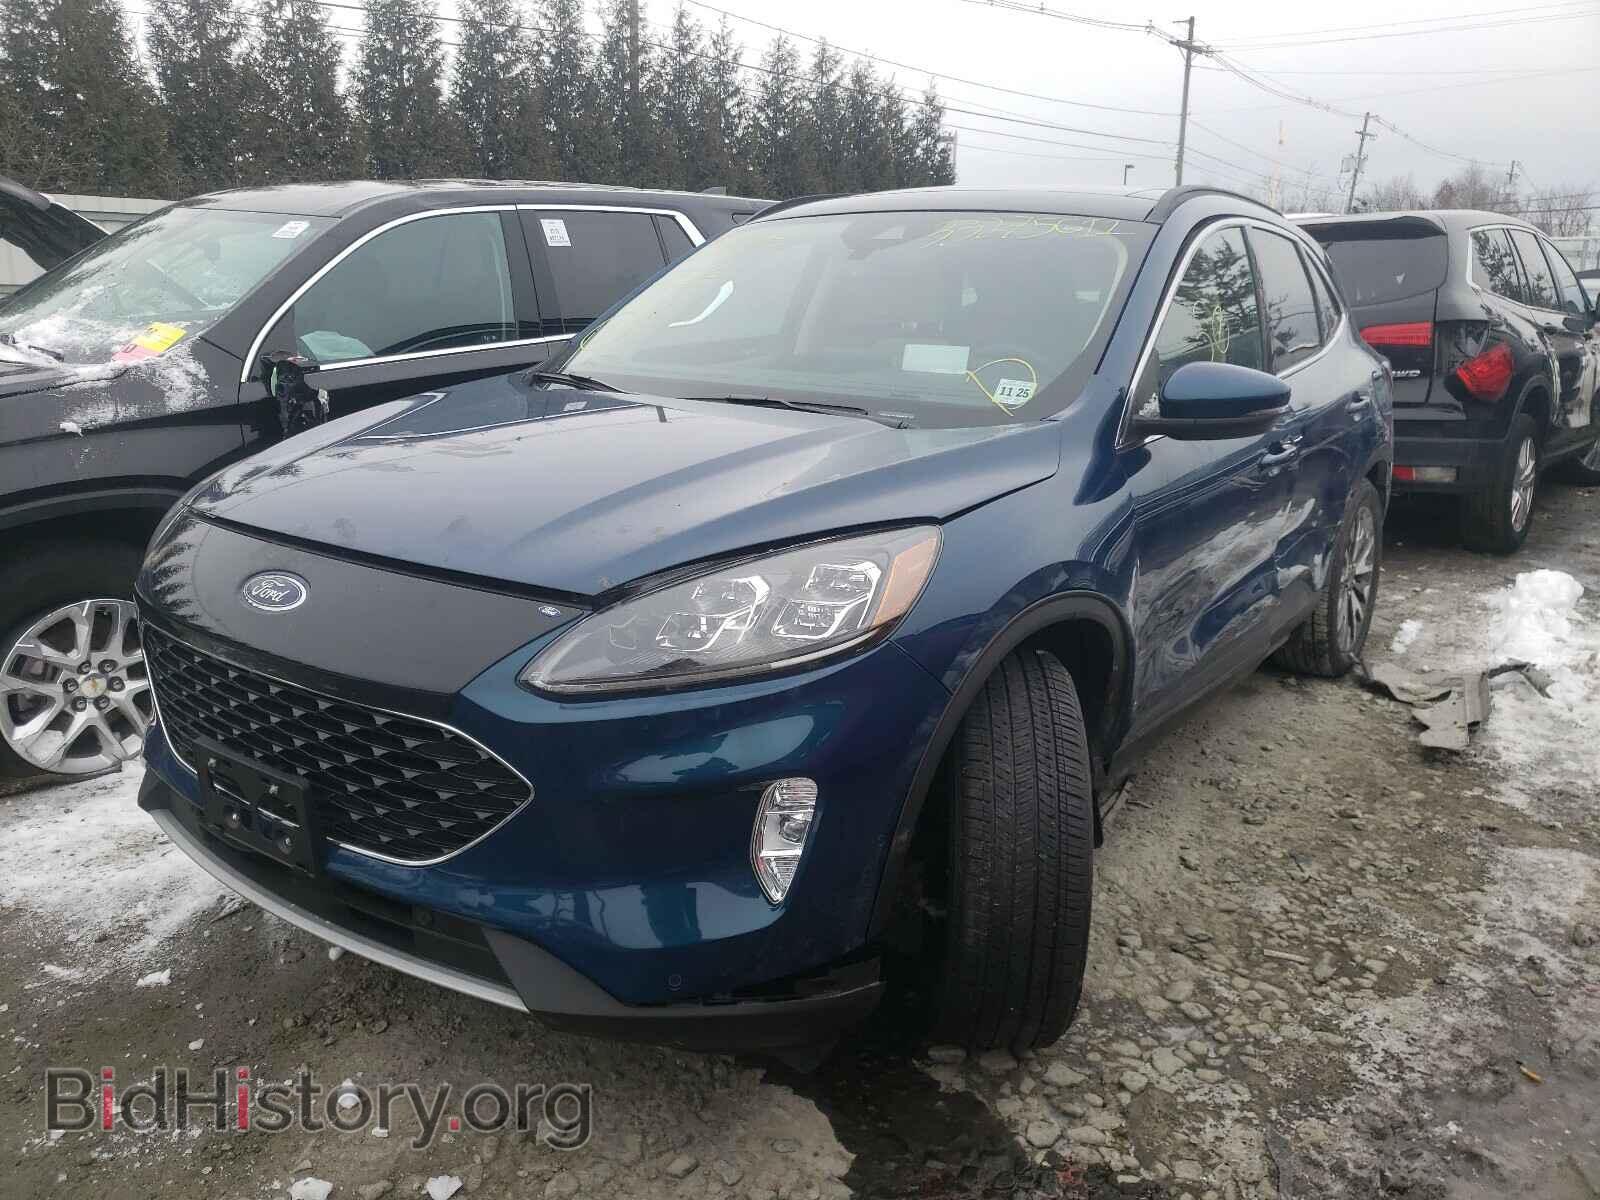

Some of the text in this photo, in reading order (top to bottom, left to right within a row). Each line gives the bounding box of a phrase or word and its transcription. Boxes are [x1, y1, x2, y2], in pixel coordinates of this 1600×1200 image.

[1000, 386, 1031, 398] 11 25
[251, 579, 291, 602] Ford
